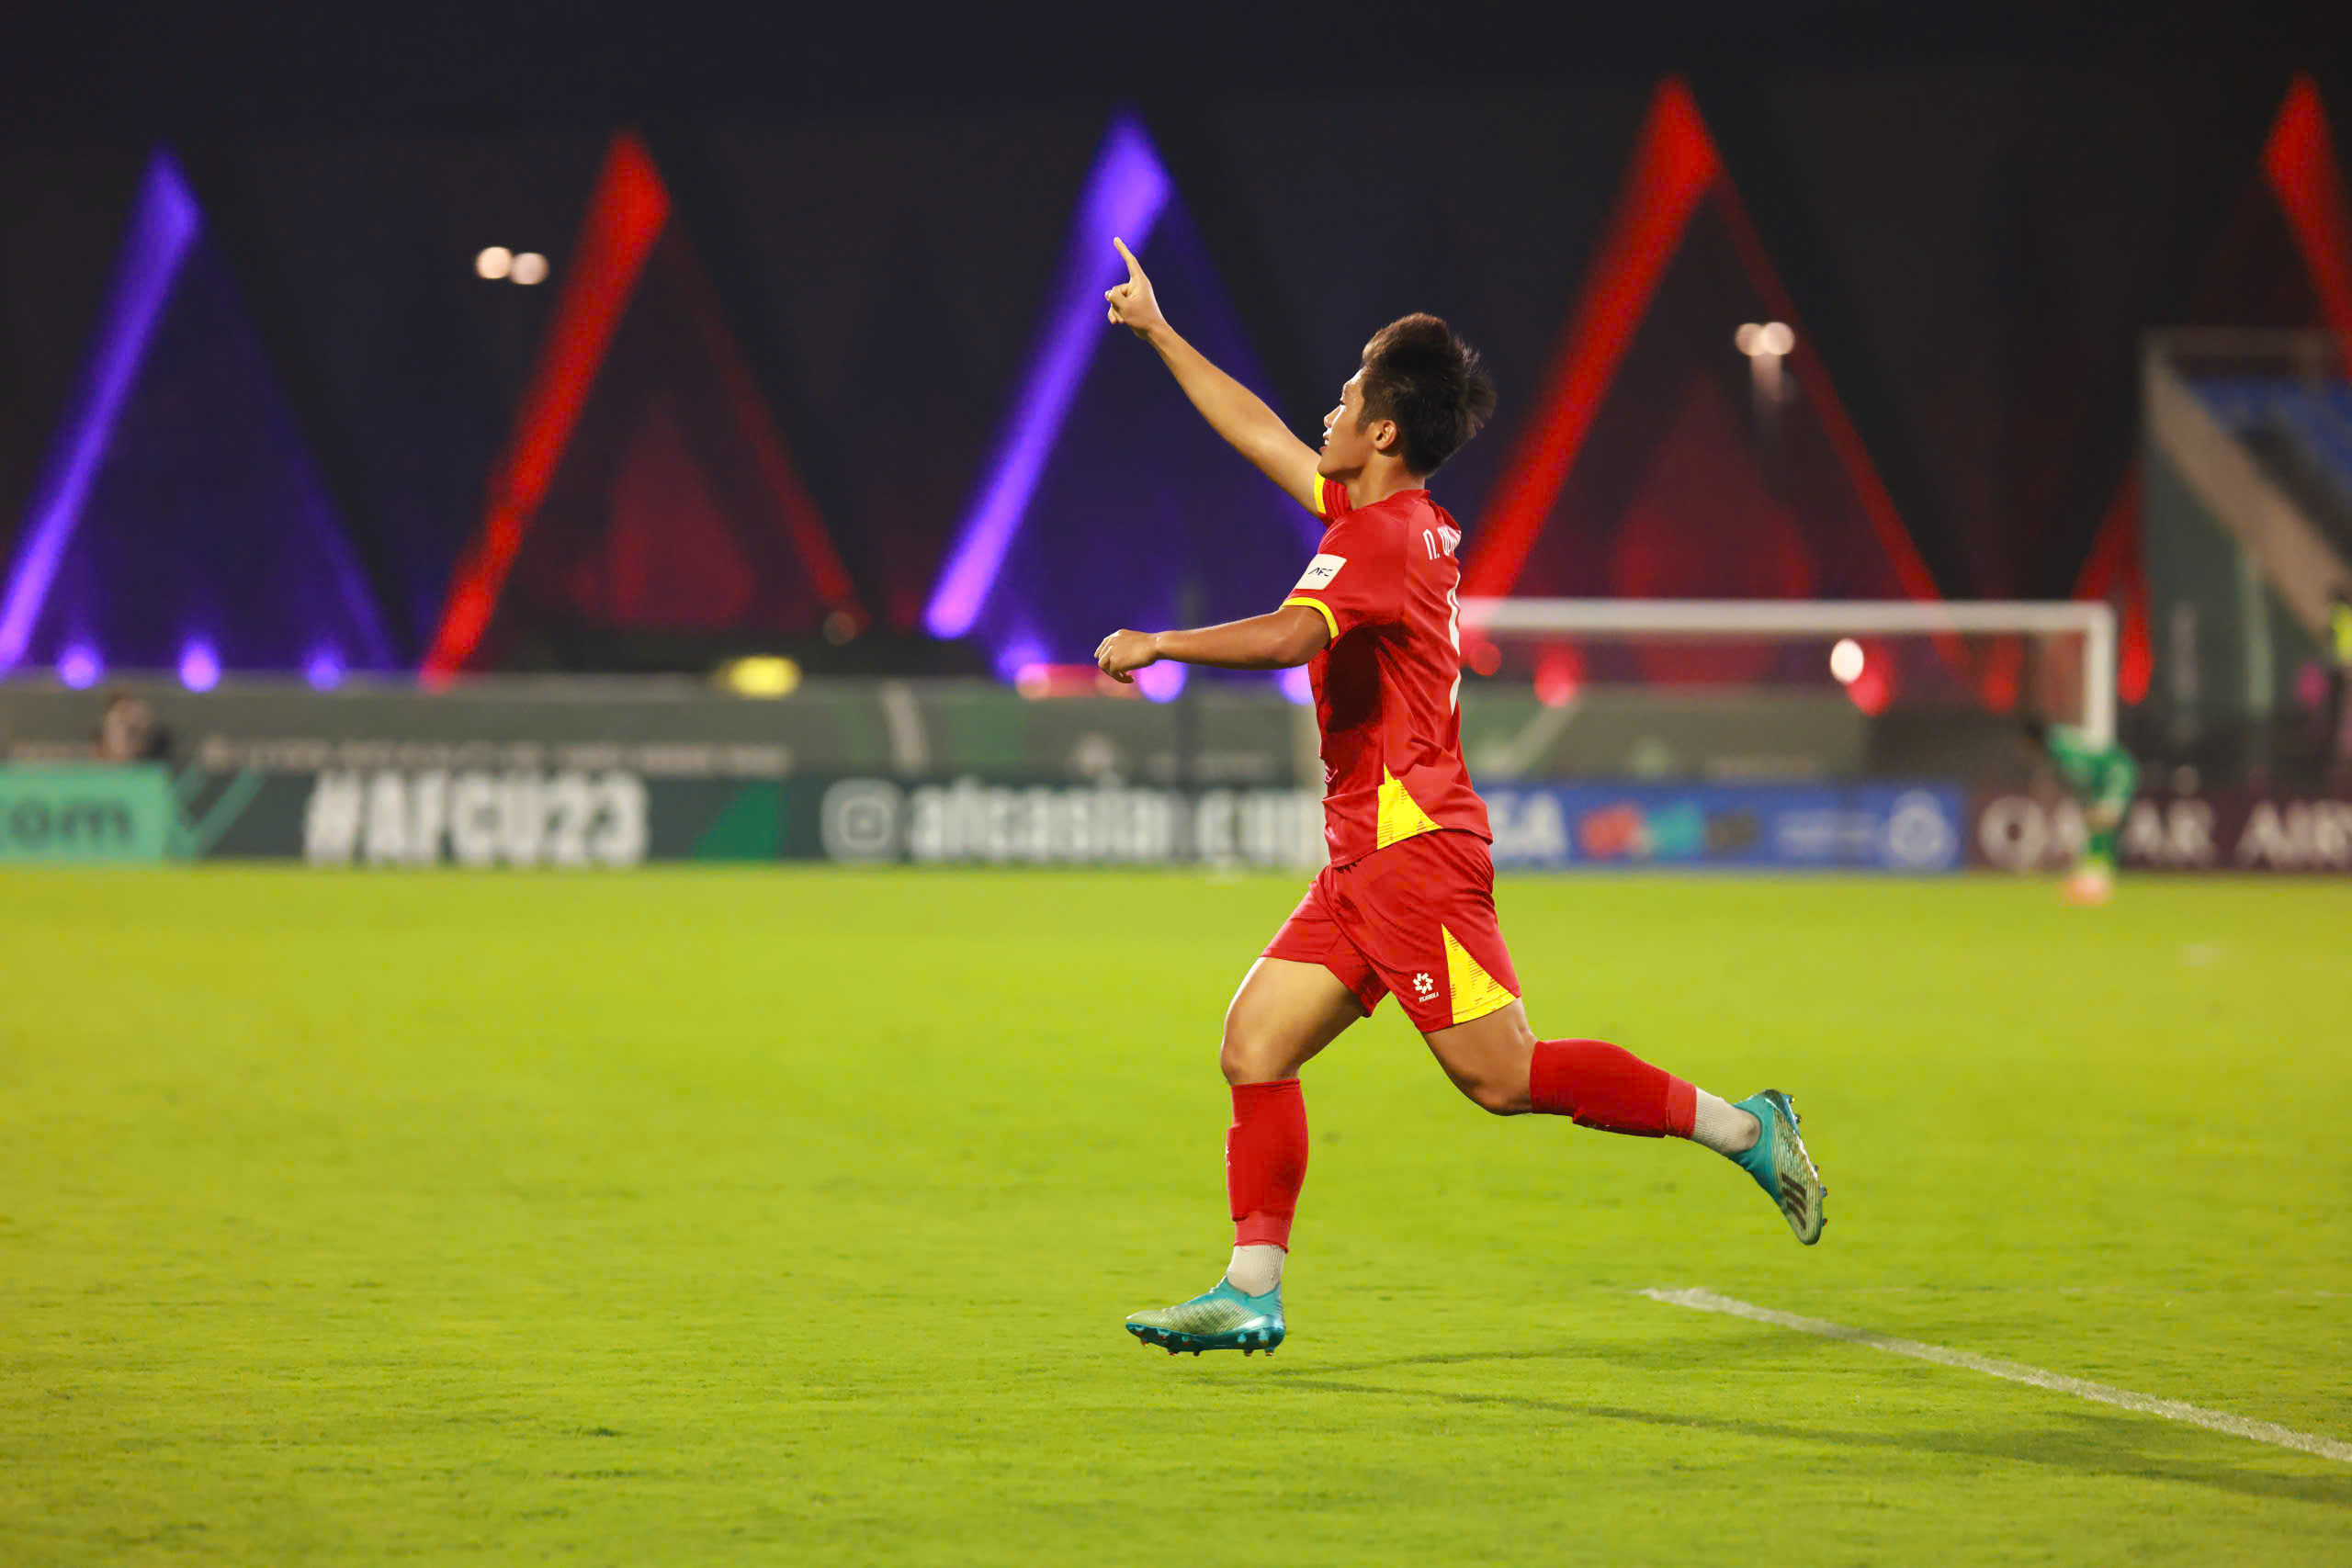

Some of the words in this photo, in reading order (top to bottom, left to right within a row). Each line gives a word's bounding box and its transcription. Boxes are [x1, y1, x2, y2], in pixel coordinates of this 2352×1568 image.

[1307, 567, 1333, 577] AFC
[0, 797, 135, 851] om
[305, 770, 649, 866] #AFCU23
[1978, 795, 2216, 869] QAAR
